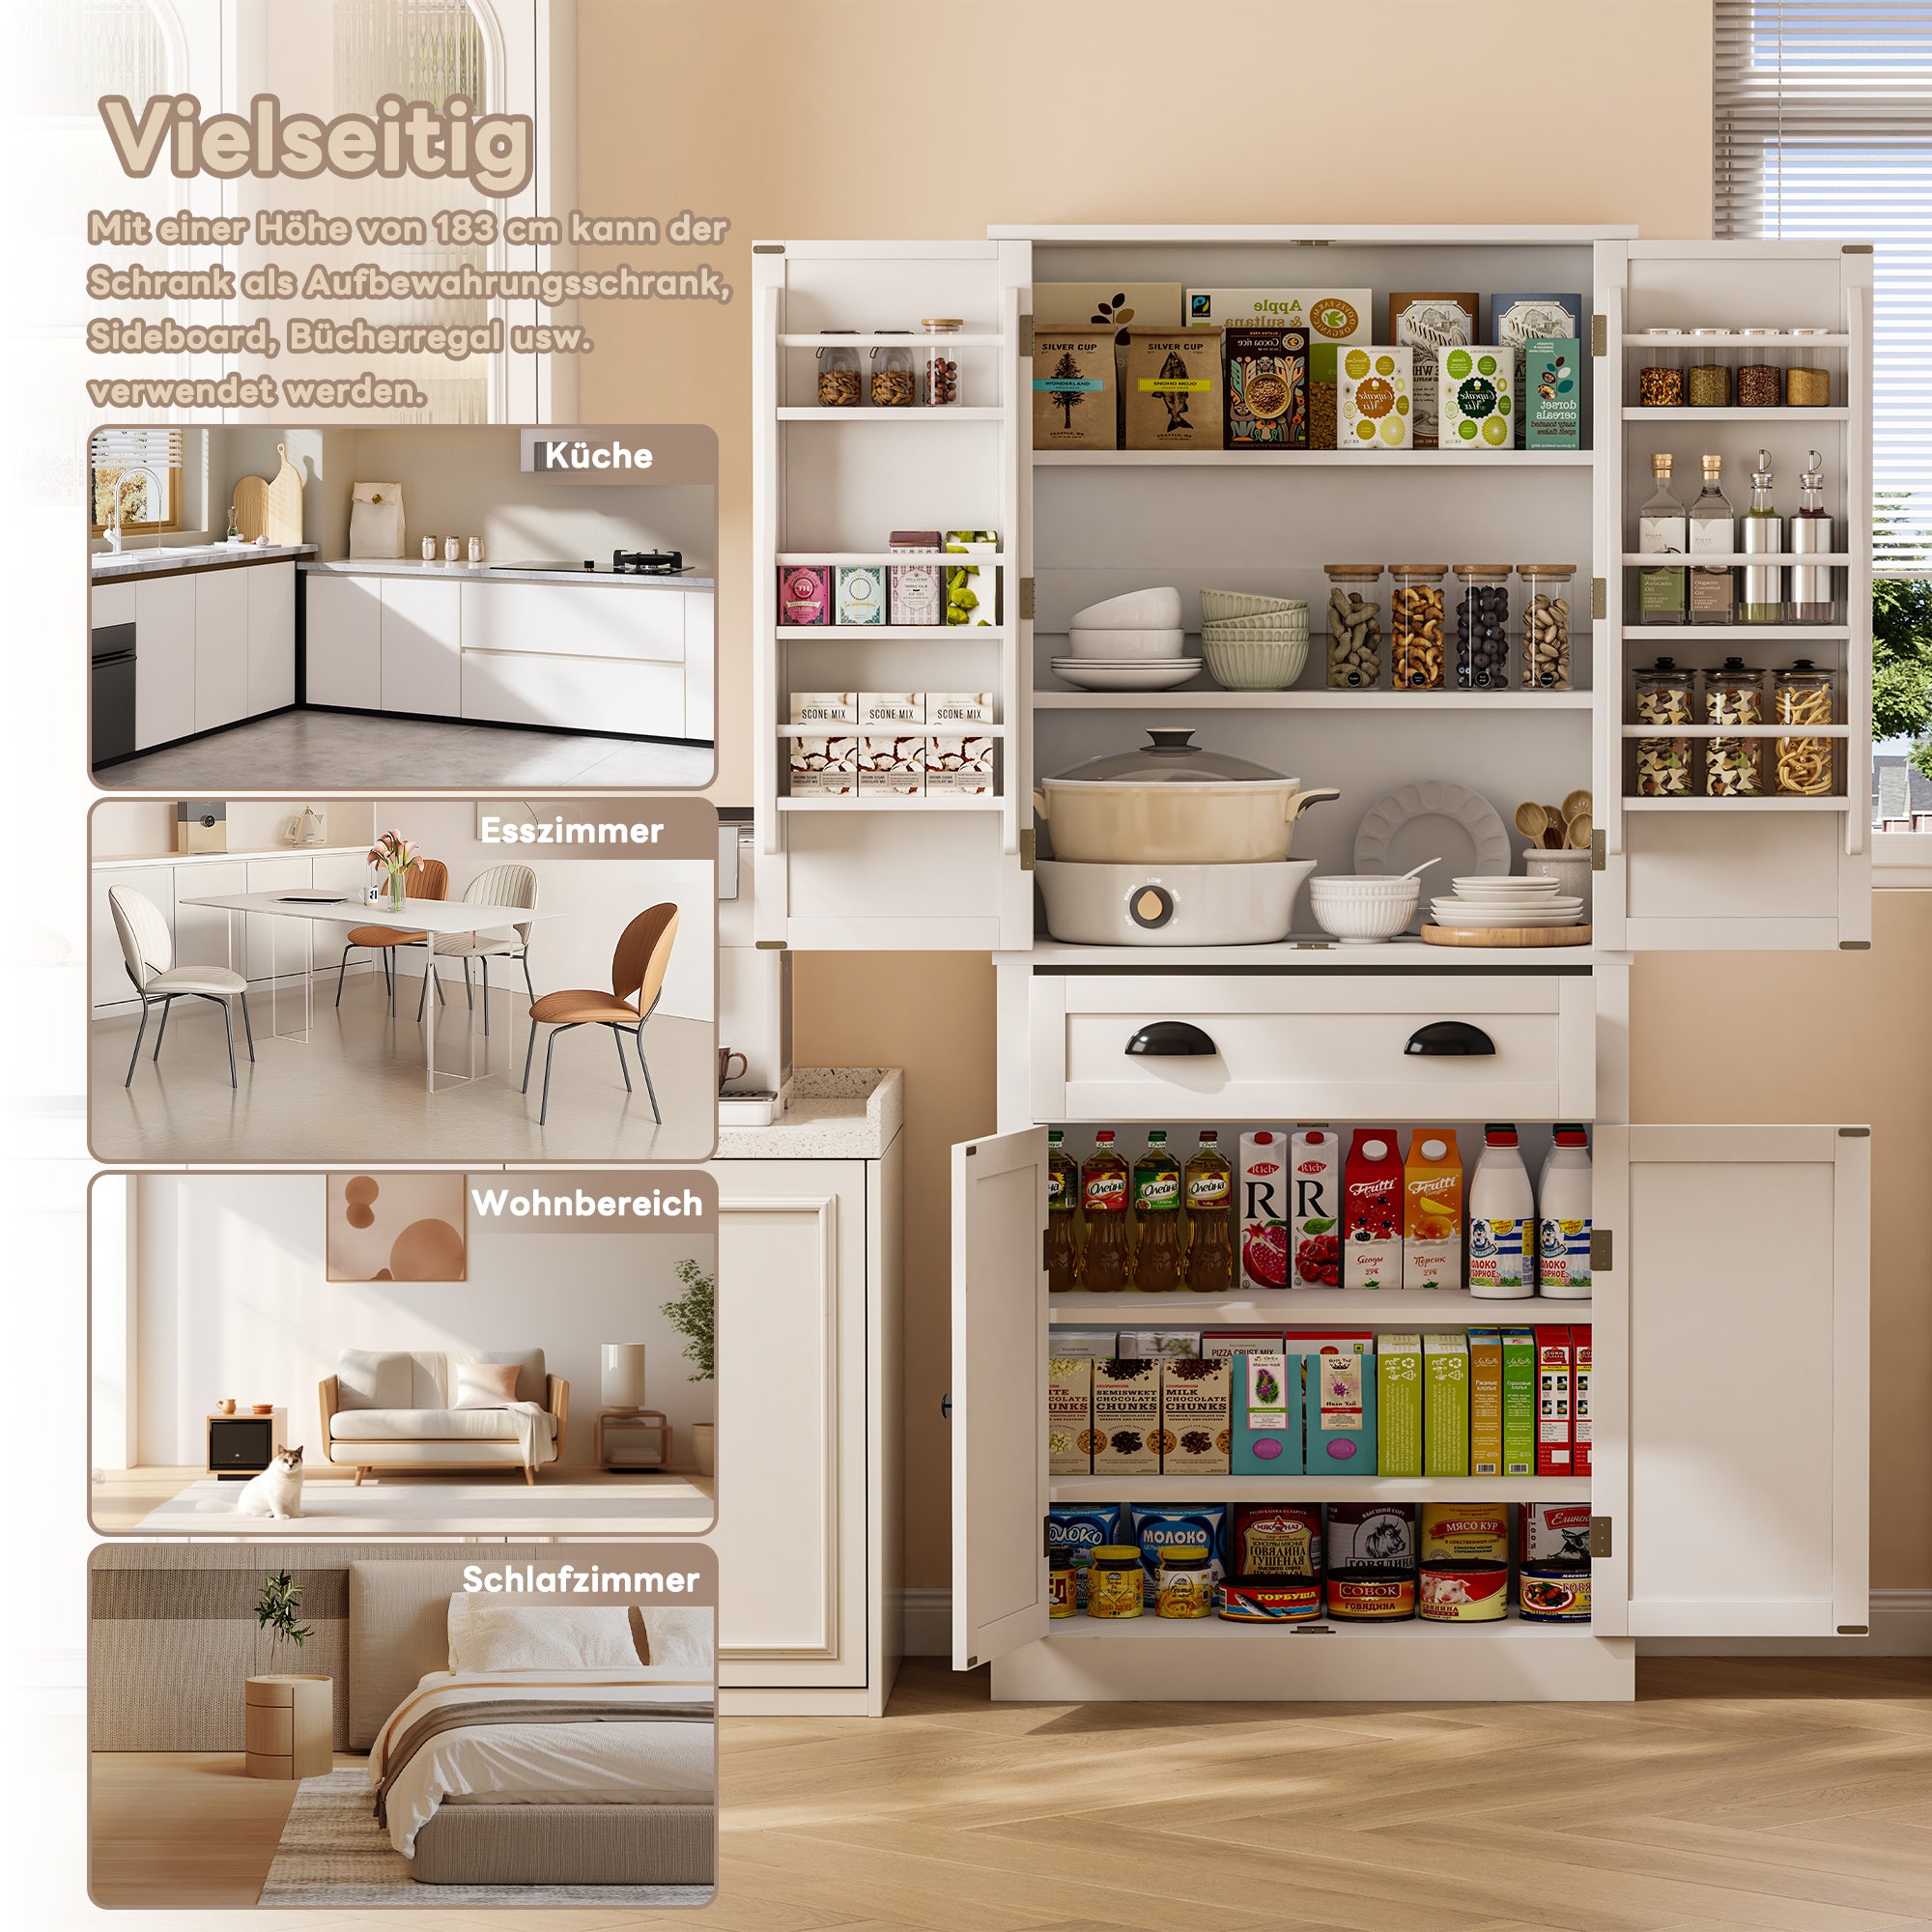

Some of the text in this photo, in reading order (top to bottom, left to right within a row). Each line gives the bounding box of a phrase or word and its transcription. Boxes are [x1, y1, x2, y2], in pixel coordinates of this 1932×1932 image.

[801, 709, 846, 719] SCONE MIX
[869, 709, 914, 719] SCONE MIX
[937, 709, 981, 719] SCONE MIX
[1252, 1165, 1275, 1174] Rich
[1301, 1163, 1322, 1172] Rich
[1090, 1181, 1124, 1195] Олейна
[1143, 1181, 1178, 1196] Олейна
[1190, 1181, 1224, 1194] Олейна
[1350, 1179, 1395, 1196] Frutti
[1408, 1177, 1456, 1194] Frutti
[1244, 1181, 1281, 1219] R
[1295, 1180, 1330, 1218] R
[1446, 1522, 1498, 1532] МЯСО КУР
[1143, 1529, 1207, 1544] МОЛОКО
[1250, 1546, 1306, 1557] ГОВЯДИНА
[1252, 1556, 1304, 1565] ТУШЕНАЯ
[1342, 1585, 1397, 1596] СОВОК
[1562, 1583, 1591, 1592] ГОВЯ
[1257, 1591, 1316, 1601] ГОРБУША
[1345, 1602, 1395, 1611] ГОВЯДИНА
